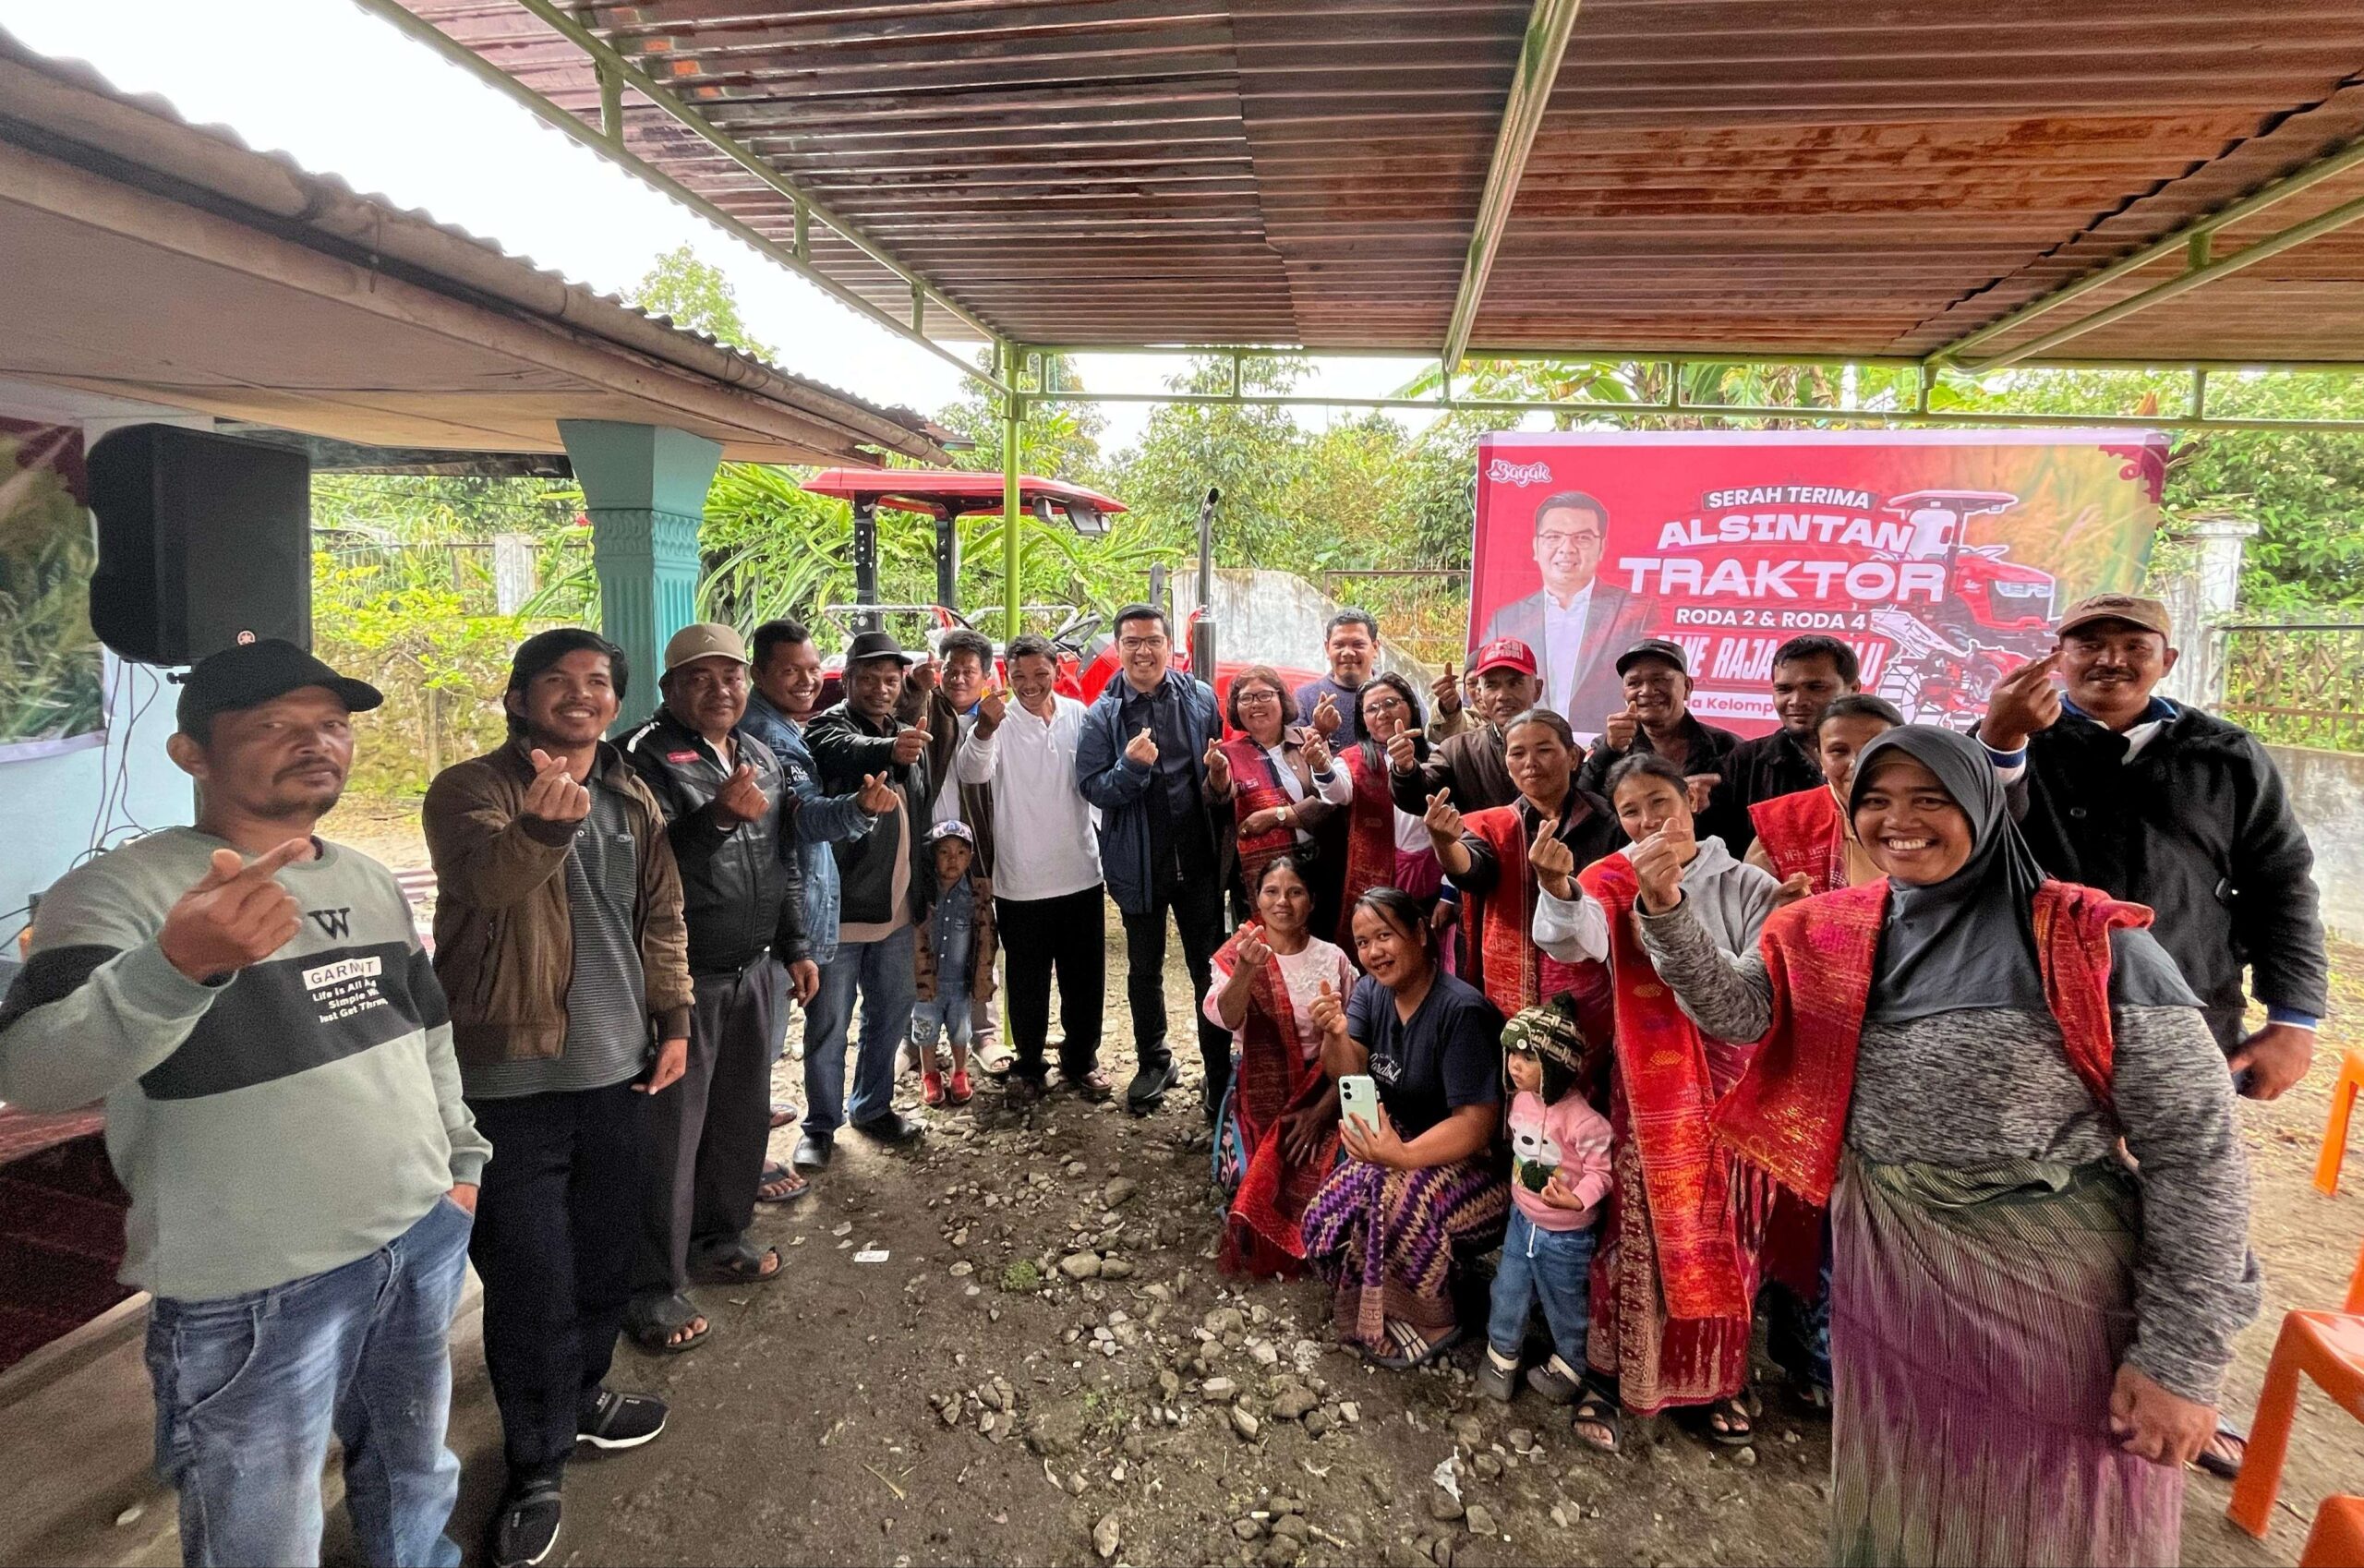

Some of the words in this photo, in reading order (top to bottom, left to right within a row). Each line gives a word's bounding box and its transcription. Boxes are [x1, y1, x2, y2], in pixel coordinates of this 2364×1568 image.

[1708, 487, 1783, 508] SERAH
[1787, 487, 1869, 509] TERIMA
[1657, 513, 1914, 553] ALSINTAN
[1619, 557, 1947, 602] TRAKTOR
[1676, 609, 1738, 626] RODA
[1742, 609, 1755, 626] 2
[1759, 610, 1776, 627] &
[1781, 611, 1846, 629] RODA
[1851, 613, 1866, 630] 4
[1707, 697, 1774, 716] Kelomp
[308, 907, 351, 940] W
[312, 990, 333, 1002] Life
[347, 980, 363, 992] All
[339, 1006, 358, 1018] Get
